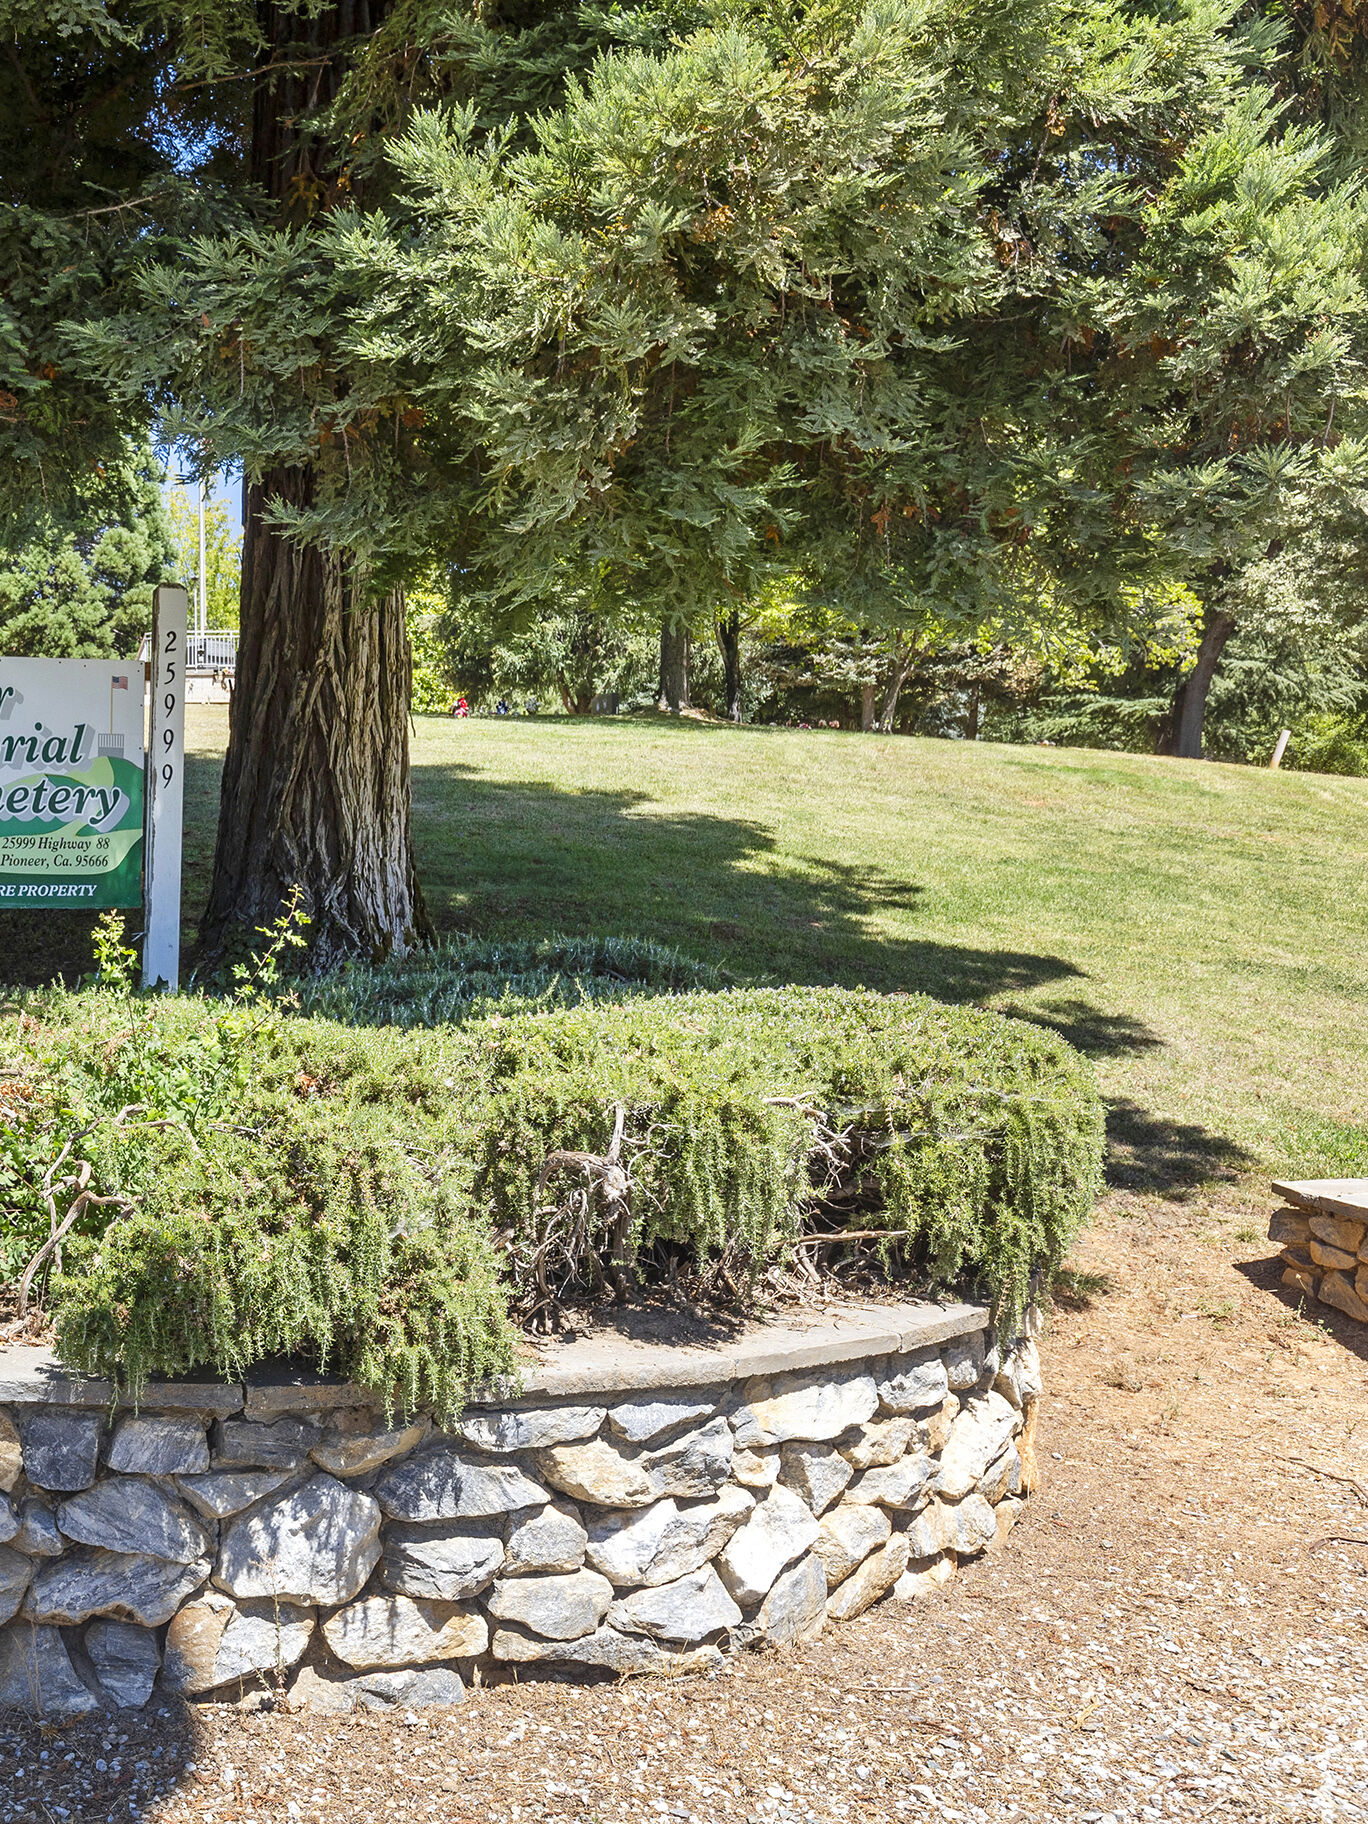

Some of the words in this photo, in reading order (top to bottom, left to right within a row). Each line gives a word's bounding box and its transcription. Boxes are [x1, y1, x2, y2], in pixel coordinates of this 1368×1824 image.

[162, 630, 178, 789] 25999
[1, 837, 36, 850] 25999
[37, 837, 92, 852] Highway
[95, 837, 111, 850] 88
[0, 854, 50, 869] Pioneer,
[53, 854, 73, 867] Ca.
[75, 854, 109, 867] 95666
[17, 884, 98, 897] PROPERTY
